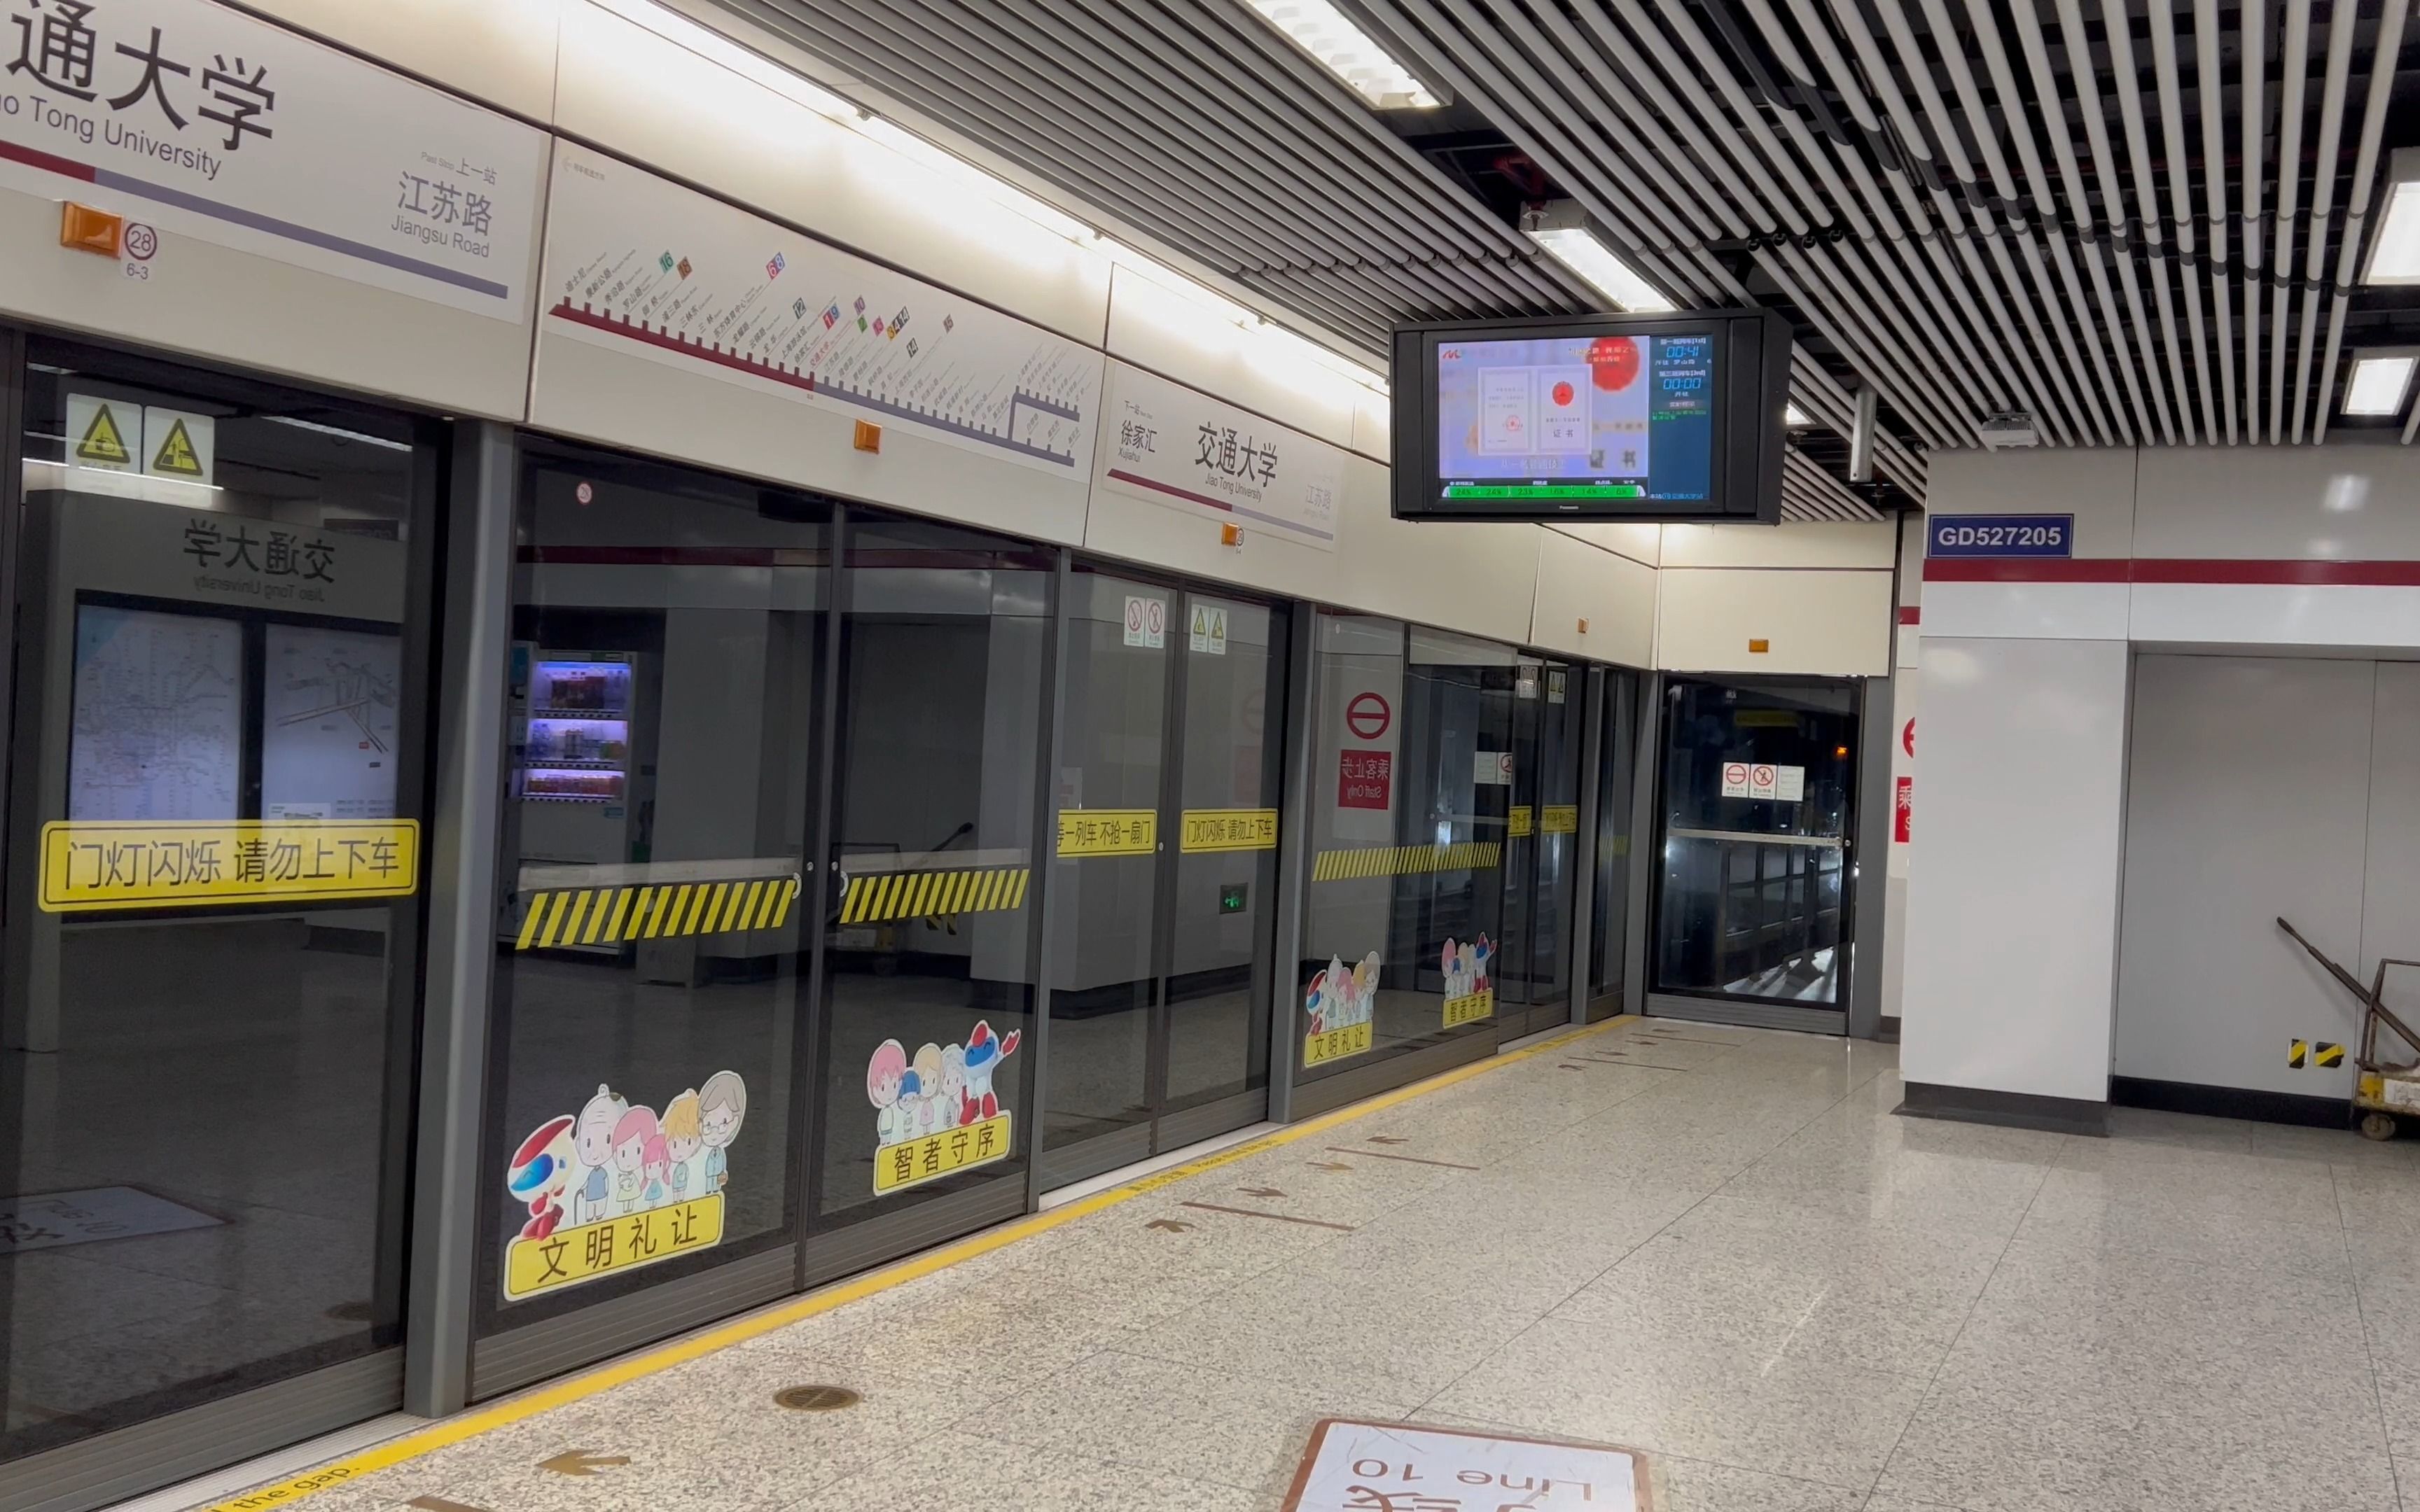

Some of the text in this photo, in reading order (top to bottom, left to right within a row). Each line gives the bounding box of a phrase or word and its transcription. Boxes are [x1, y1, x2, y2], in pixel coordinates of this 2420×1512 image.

[30, 96, 95, 144] Tong
[106, 120, 221, 181] University
[456, 158, 497, 186] 上一站
[398, 170, 493, 237] 江苏路
[130, 230, 151, 252] 28
[391, 215, 489, 258] Jiangsu Road
[127, 262, 148, 280] 6-3
[660, 251, 674, 272] 16
[768, 254, 784, 278] 6 8
[793, 298, 806, 319] 12
[825, 305, 839, 328] 1 9
[854, 296, 866, 315] 10
[944, 314, 954, 334] 15
[906, 338, 918, 358] 14
[1667, 345, 1699, 358] 00:41
[1663, 377, 1702, 390] 00:00
[1121, 419, 1157, 453] 徐家汇
[1195, 421, 1278, 488] 交通大学
[1205, 473, 1263, 503] Jiao Tong University
[1938, 526, 2062, 547] GD527205
[1099, 819, 1151, 846] 不抢一扇门
[1186, 817, 1273, 843] 门灯闪烁 请勿上下车
[66, 836, 399, 890] 门灯闪烁 请勿上下车
[1313, 1026, 1364, 1060] 文明礼让
[894, 1126, 996, 1182] 智者守序
[538, 1210, 699, 1284] 文明礼让
[1352, 1458, 1424, 1482] 10
[1456, 1469, 1592, 1502] Line
[233, 1490, 290, 1509] the
